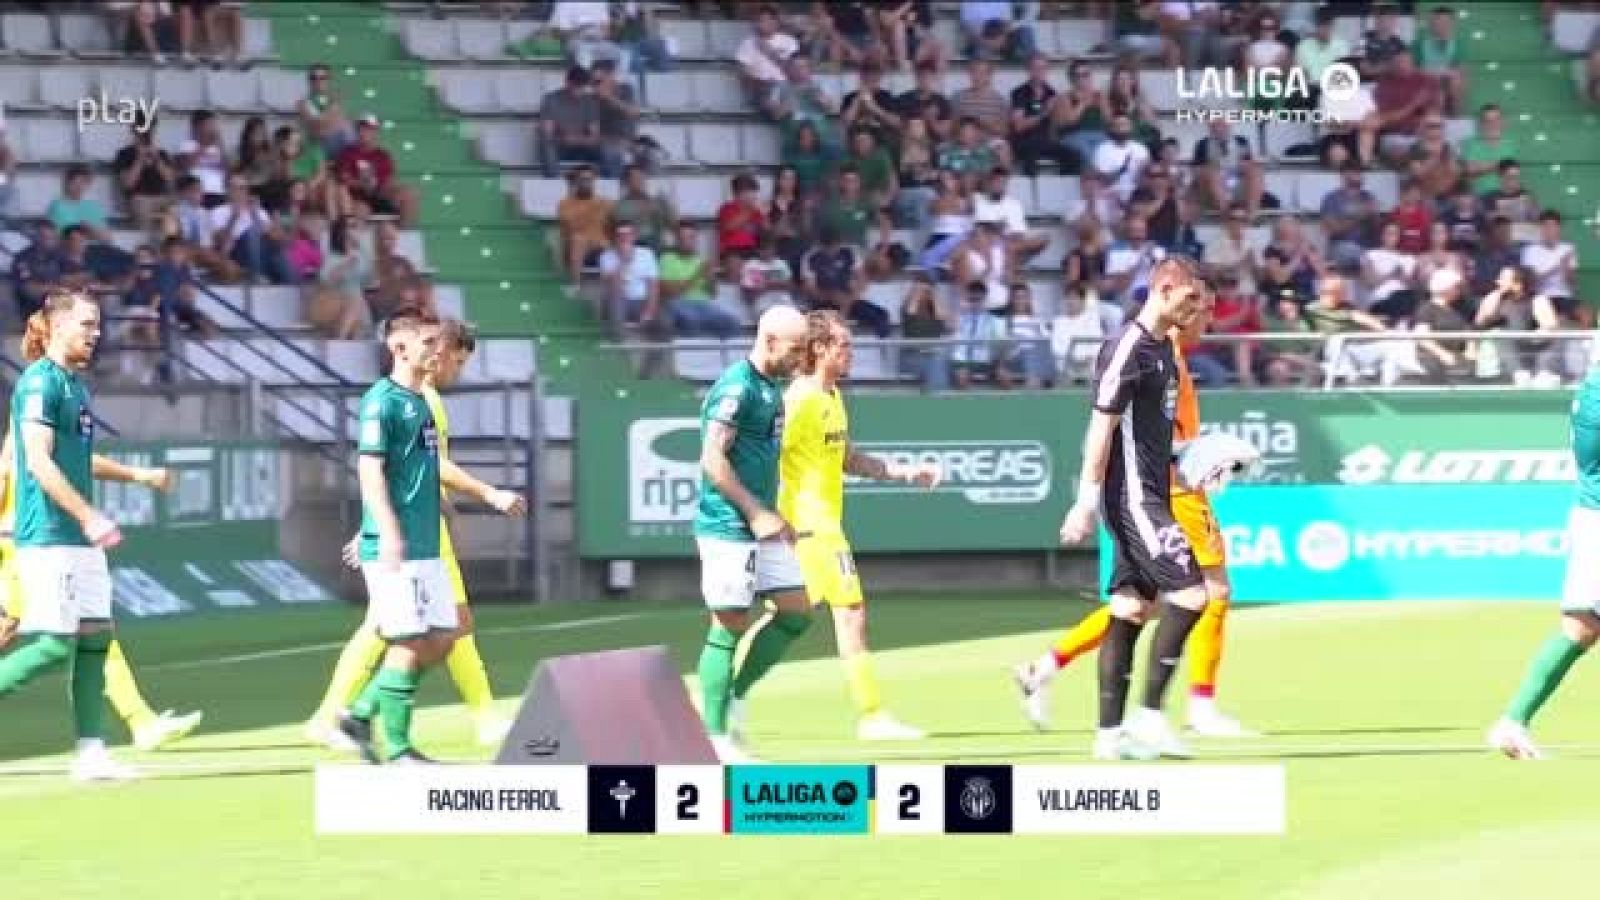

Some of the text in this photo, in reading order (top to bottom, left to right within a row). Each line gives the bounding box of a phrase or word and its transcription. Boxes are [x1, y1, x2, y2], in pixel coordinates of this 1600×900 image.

[642, 469, 696, 516] rip
[1222, 526, 1286, 567] GA
[1354, 530, 1568, 557] HYPERMO
